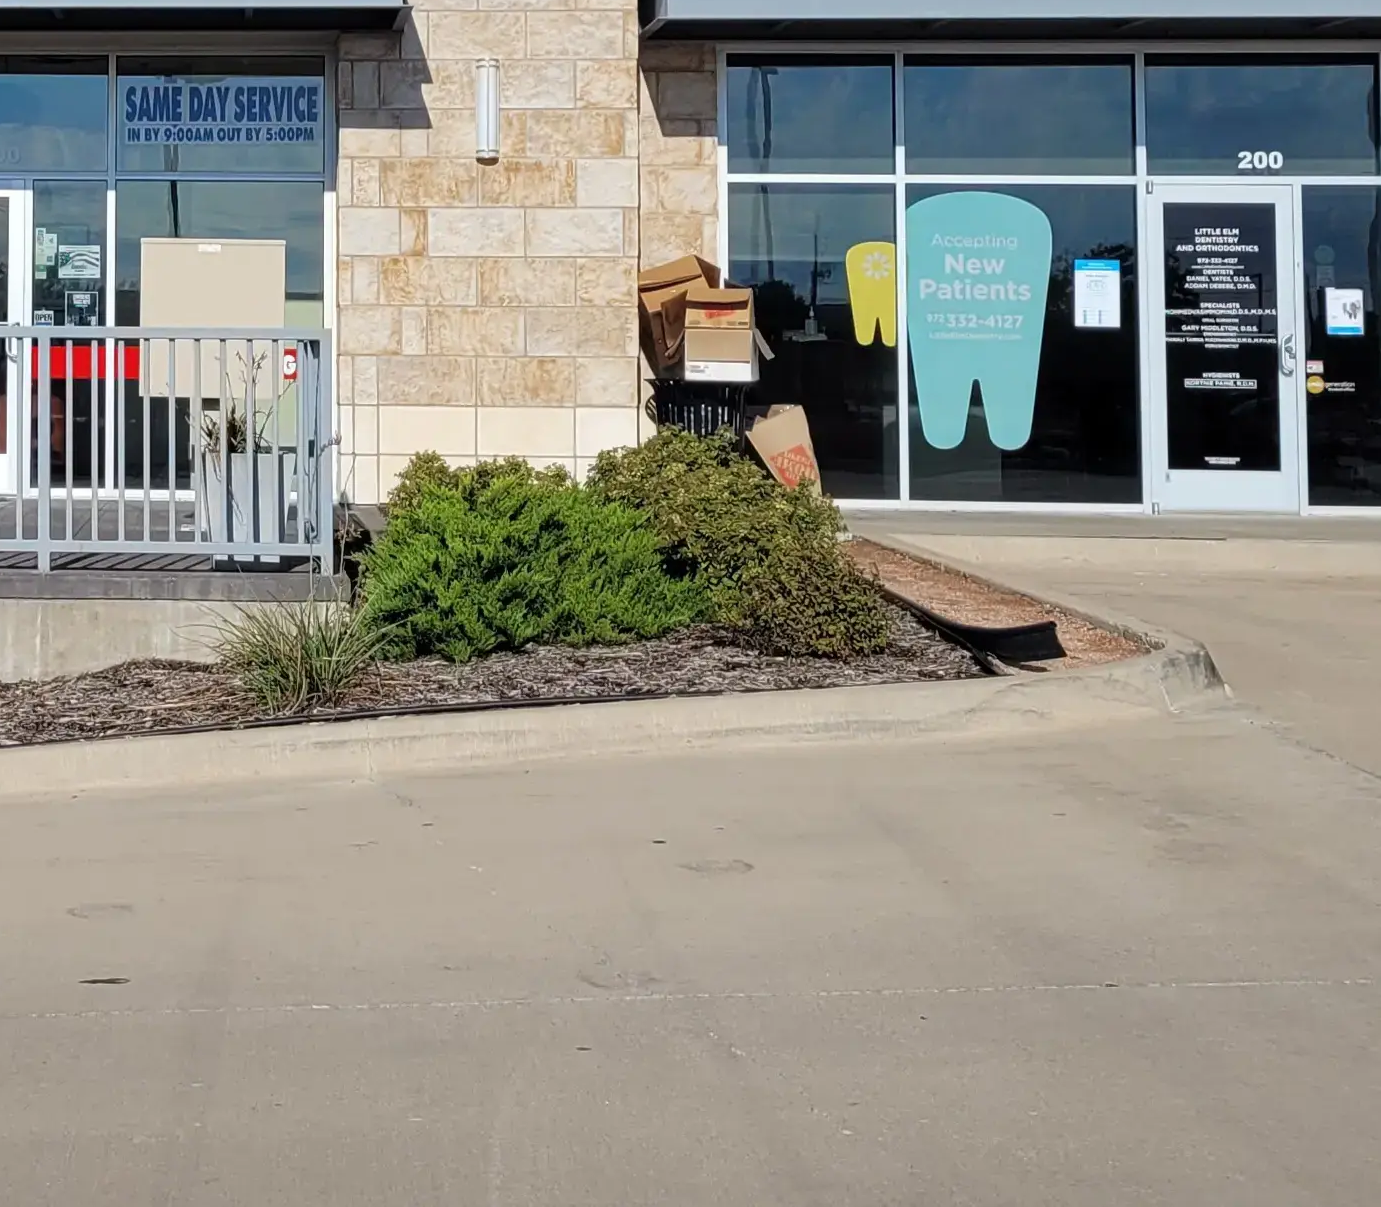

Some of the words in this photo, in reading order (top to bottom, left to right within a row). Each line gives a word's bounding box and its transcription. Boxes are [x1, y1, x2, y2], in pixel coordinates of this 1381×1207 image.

[125, 86, 183, 123] SAME
[188, 86, 231, 123] DAY
[234, 85, 318, 123] SERVICE
[127, 127, 141, 142] IN
[144, 127, 160, 142] BY
[164, 127, 214, 142] 9:00AM
[217, 127, 243, 142] OUT
[246, 127, 263, 142] BY
[266, 127, 315, 142] 5:00PM
[1237, 151, 1284, 169] 200
[931, 233, 1018, 250] Accepting
[1195, 236, 1239, 244] DENTISTRY
[944, 253, 1006, 274] New
[919, 278, 1032, 300] Patients
[35, 313, 53, 322] OPEN
[946, 313, 1024, 329] 332-4127
